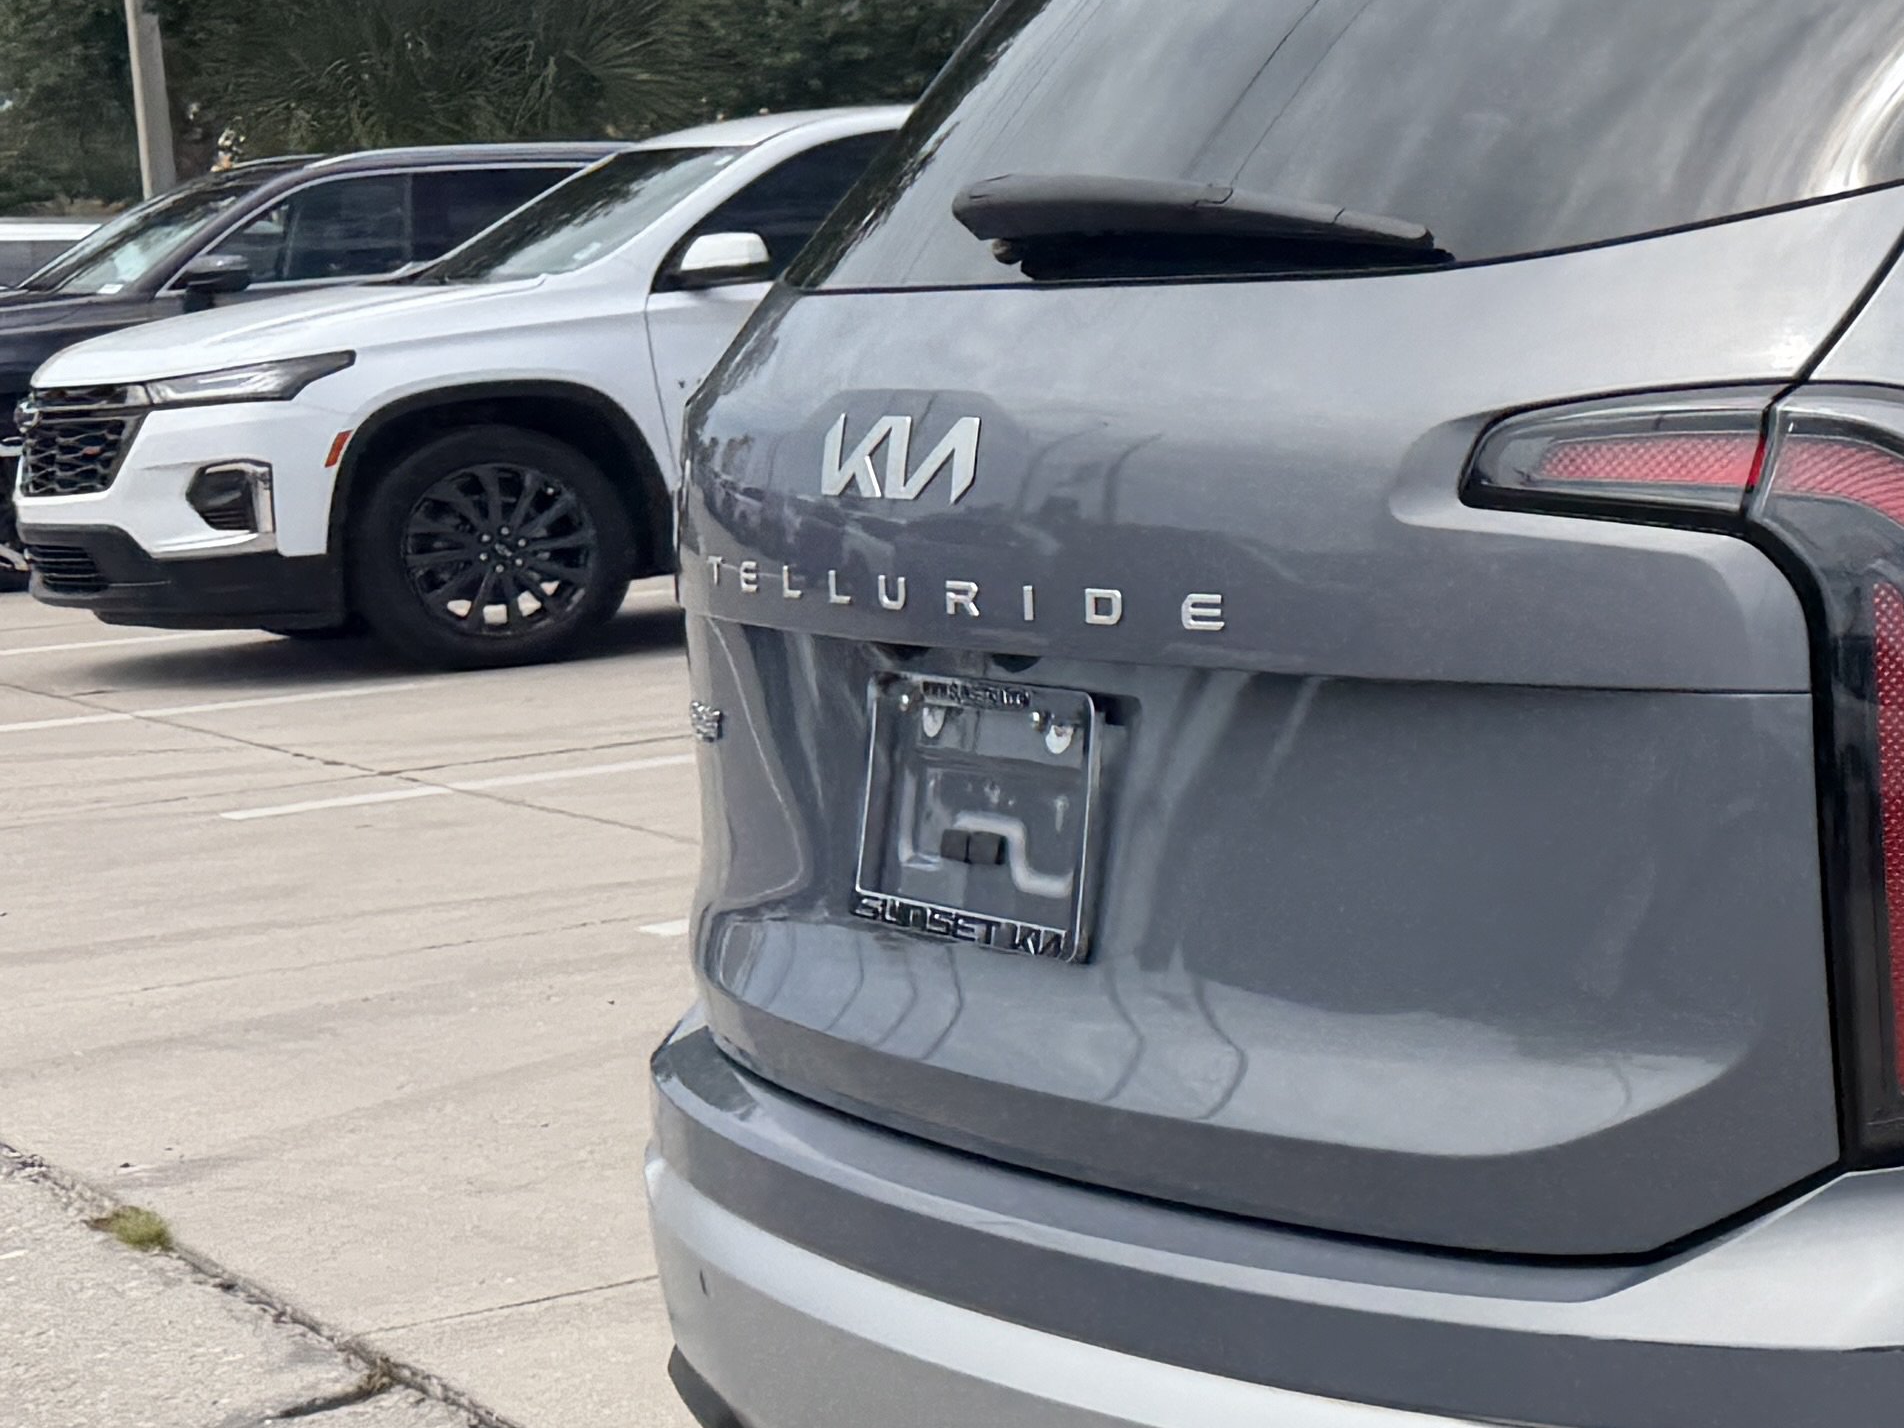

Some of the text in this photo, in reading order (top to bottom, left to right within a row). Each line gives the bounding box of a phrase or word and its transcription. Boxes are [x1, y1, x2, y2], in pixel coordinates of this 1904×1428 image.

[821, 413, 980, 503] KIA
[706, 555, 1226, 632] TELLURIDE
[852, 894, 997, 945] SUNSET
